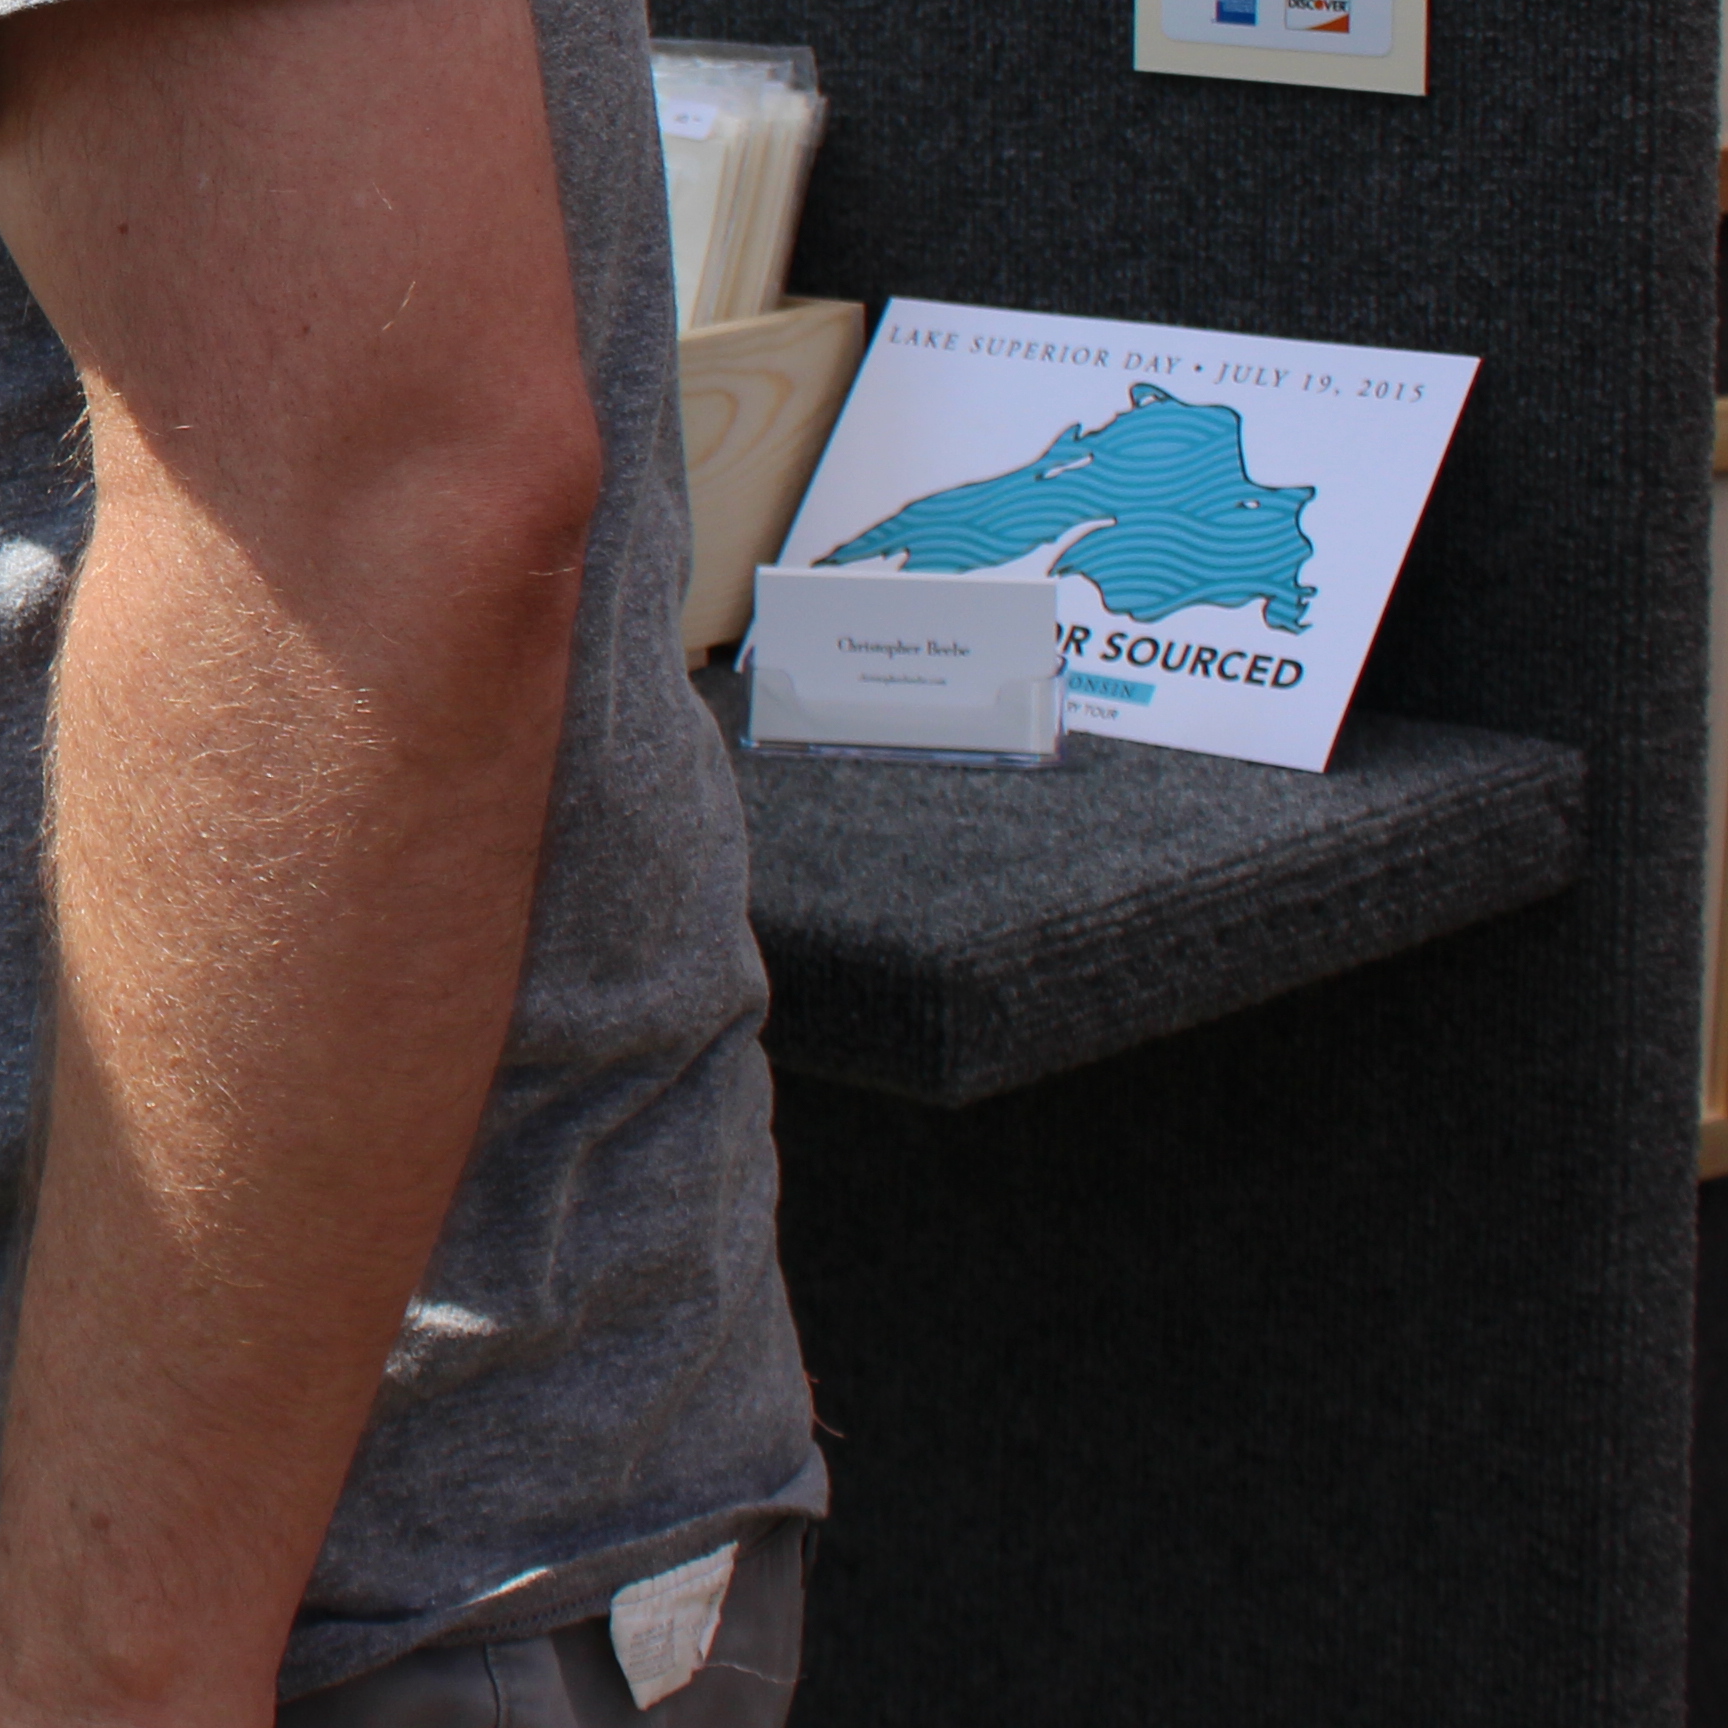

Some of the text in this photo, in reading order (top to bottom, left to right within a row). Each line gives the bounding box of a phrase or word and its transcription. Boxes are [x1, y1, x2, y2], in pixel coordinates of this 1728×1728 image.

[887, 324, 1426, 403] LAKE SUPERIOR DAY JULY 19, 2015
[836, 636, 922, 660] Christopher
[1055, 622, 1305, 690] R SOURCED
